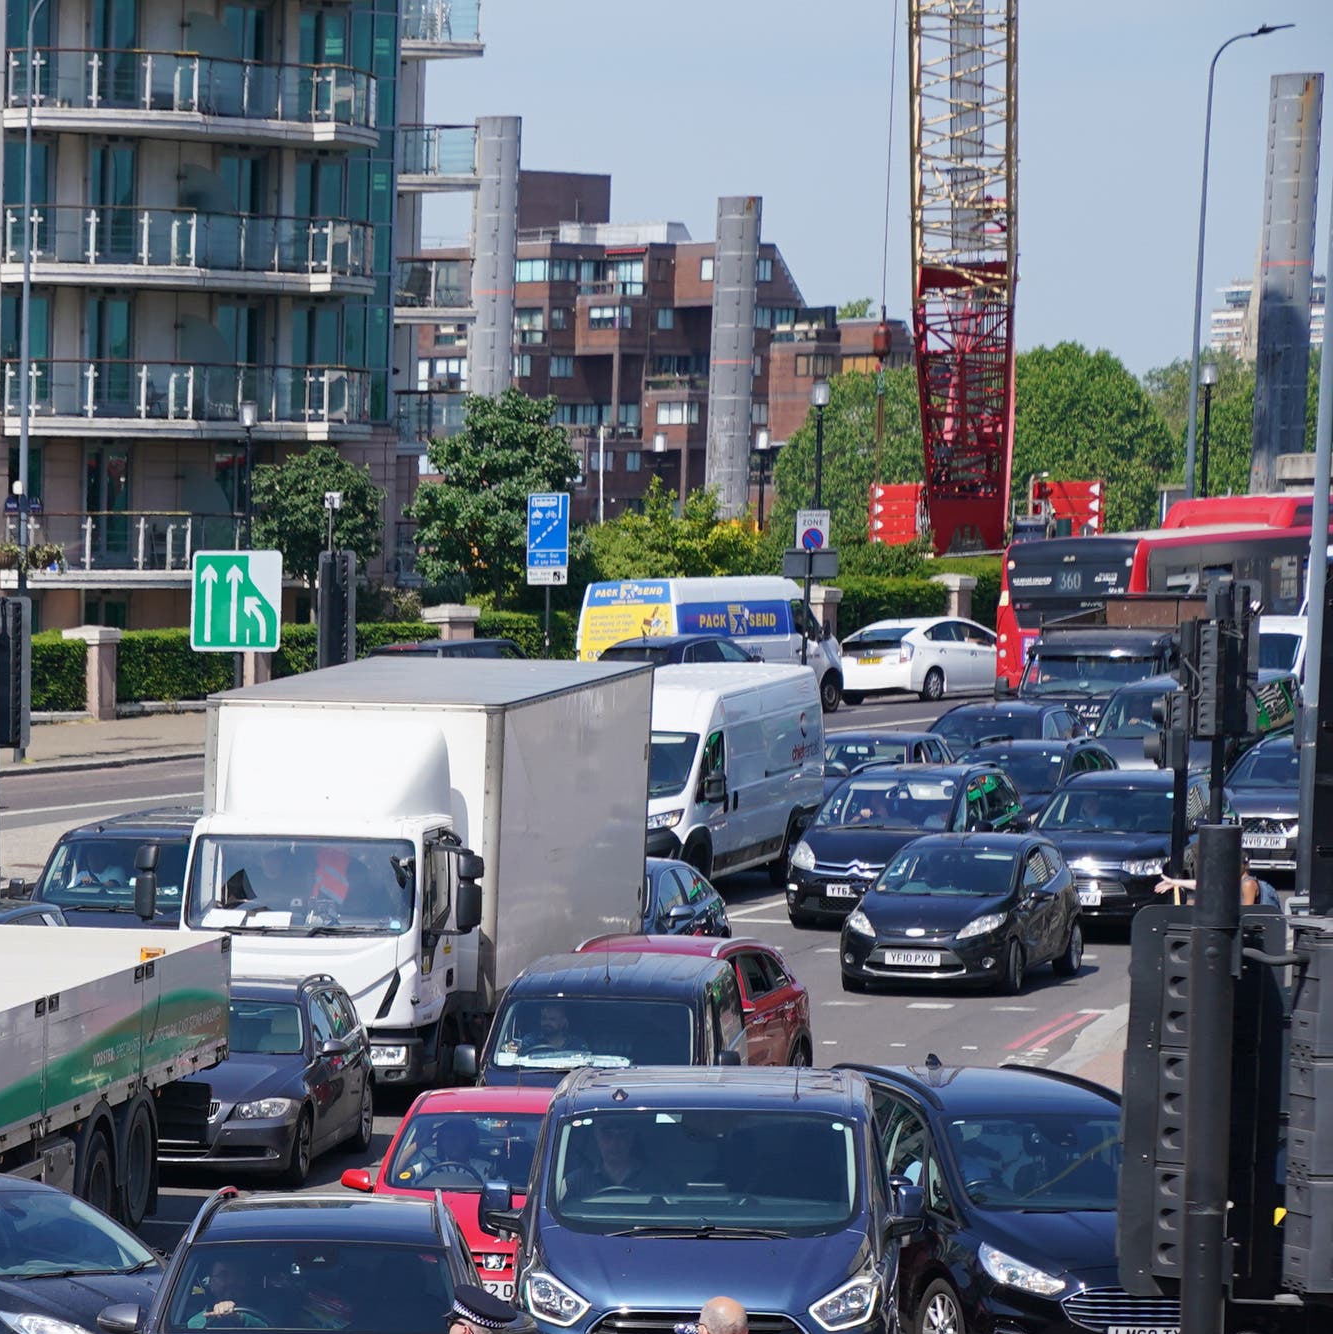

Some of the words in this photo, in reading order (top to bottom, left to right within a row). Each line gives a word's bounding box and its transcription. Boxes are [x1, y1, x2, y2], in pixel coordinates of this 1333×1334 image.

[803, 519, 824, 527] ZONE
[1060, 572, 1082, 591] 360
[699, 613, 726, 628] PACK
[749, 612, 777, 627] SEND
